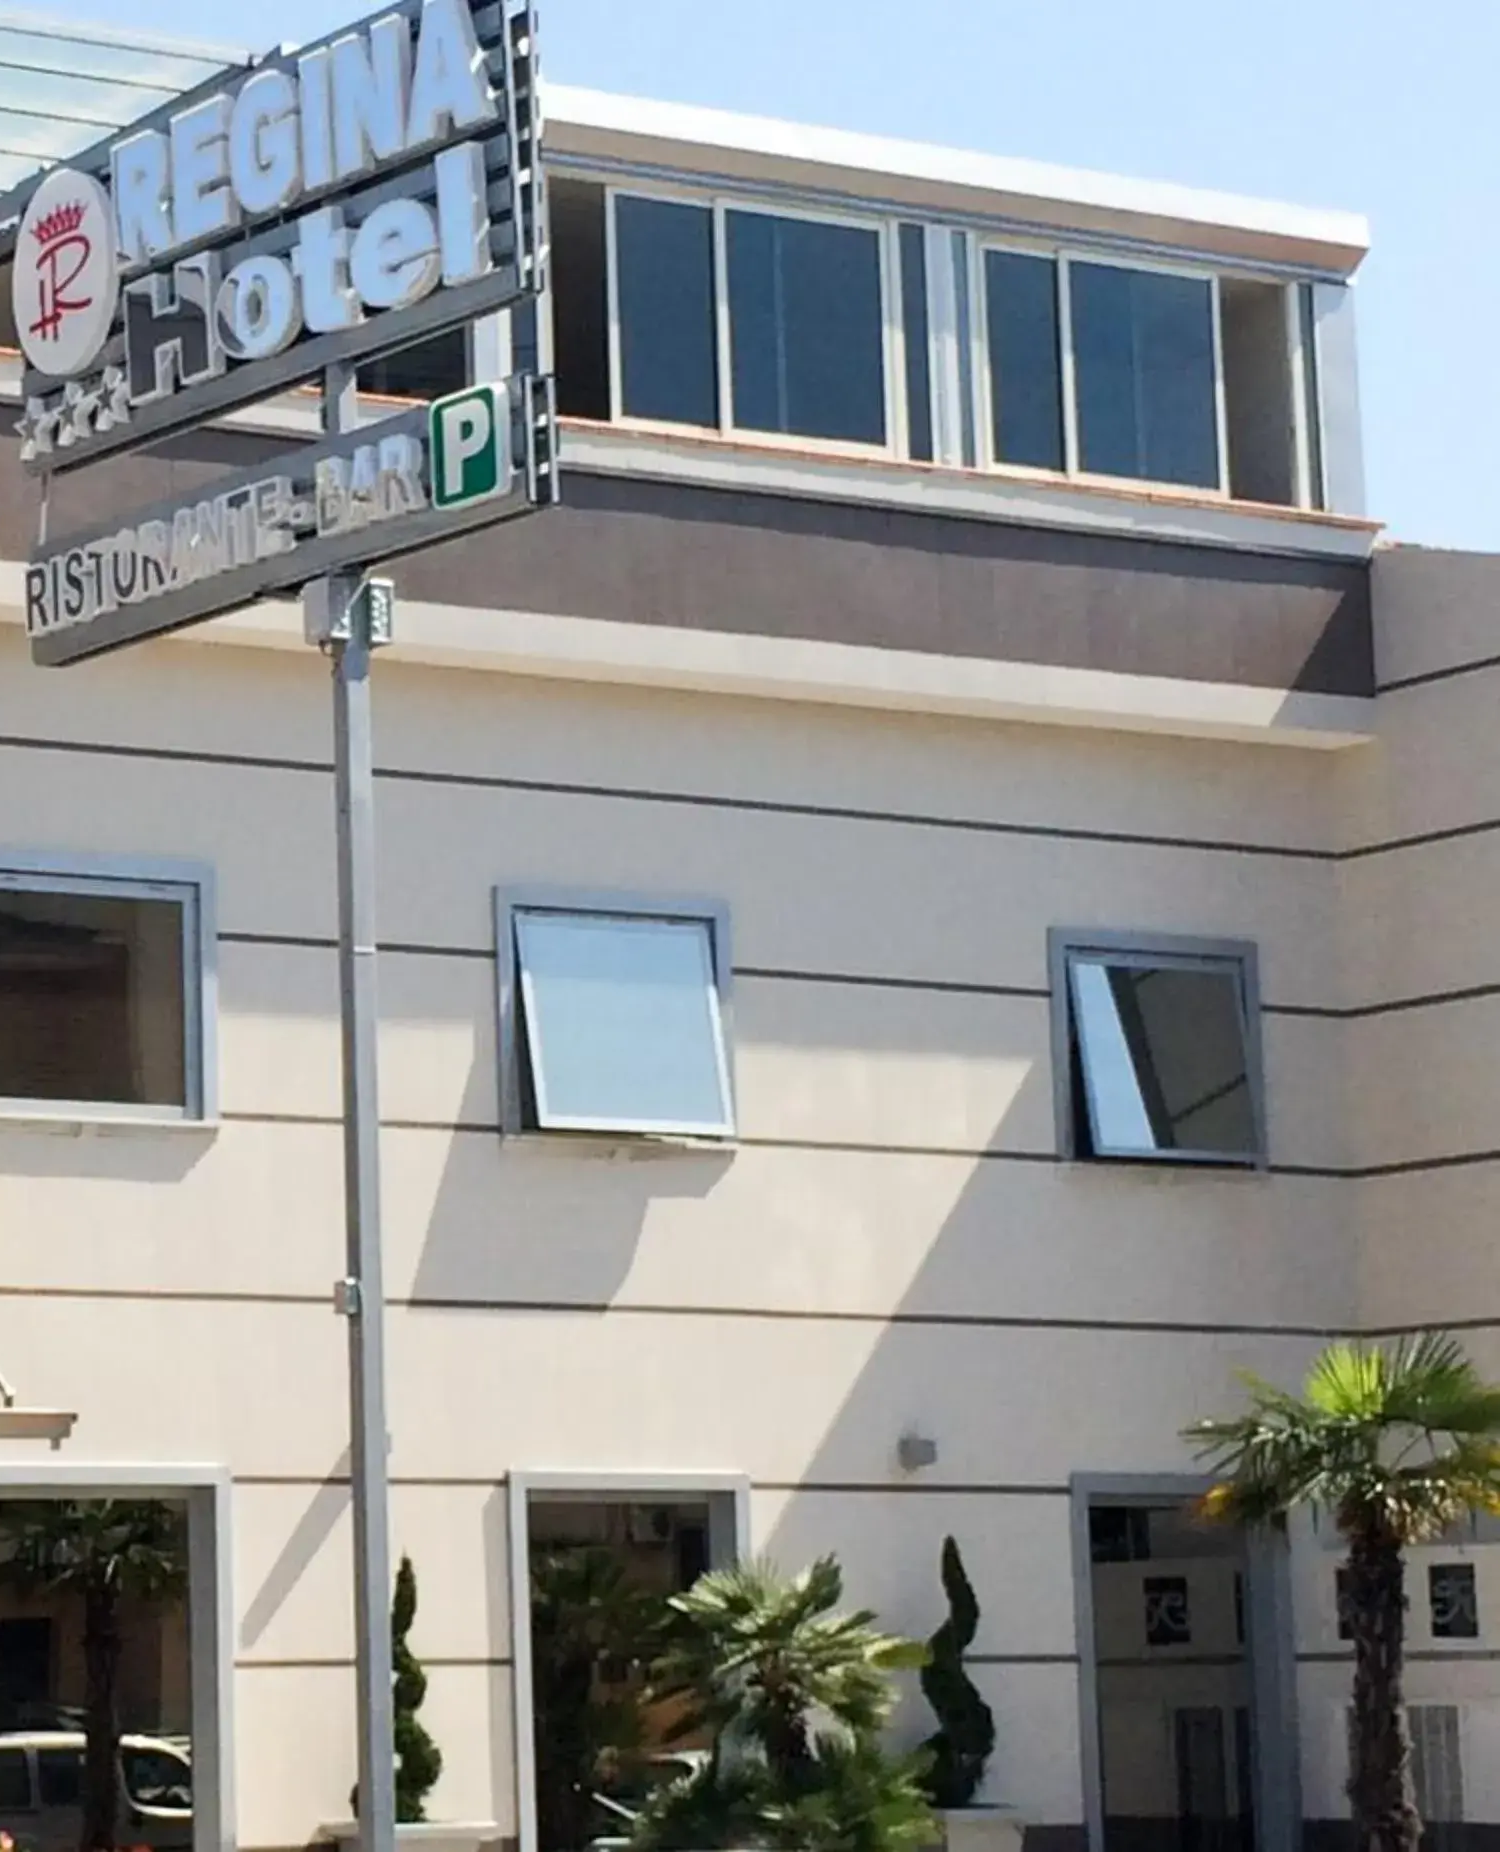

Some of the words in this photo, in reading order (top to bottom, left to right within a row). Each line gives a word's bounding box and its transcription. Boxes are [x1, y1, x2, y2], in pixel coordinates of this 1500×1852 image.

[110, 0, 497, 276] REGINA
[122, 141, 494, 405] Hotel
[315, 433, 429, 539] BAR
[443, 410, 490, 495] P
